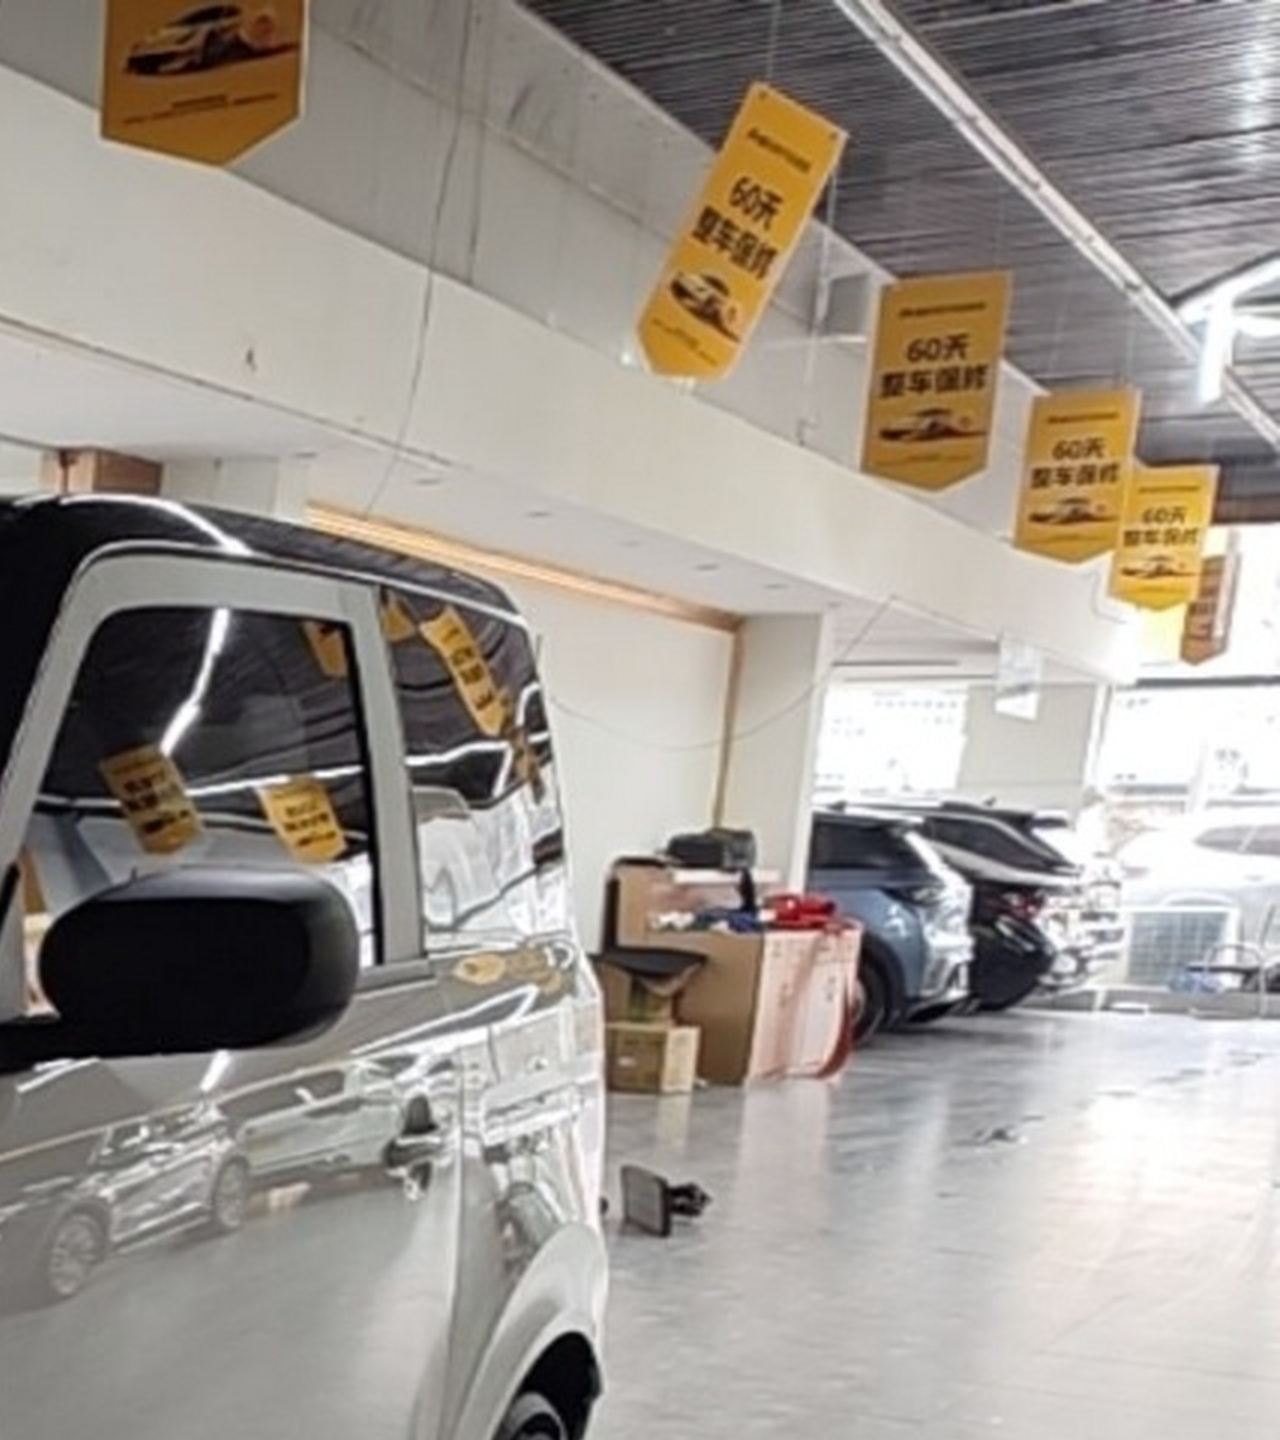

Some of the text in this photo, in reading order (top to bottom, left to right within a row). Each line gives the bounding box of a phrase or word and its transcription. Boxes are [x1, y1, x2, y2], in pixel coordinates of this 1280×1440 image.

[730, 176, 783, 231] 60天
[906, 332, 968, 362] 60天
[1052, 438, 1105, 459] 60天
